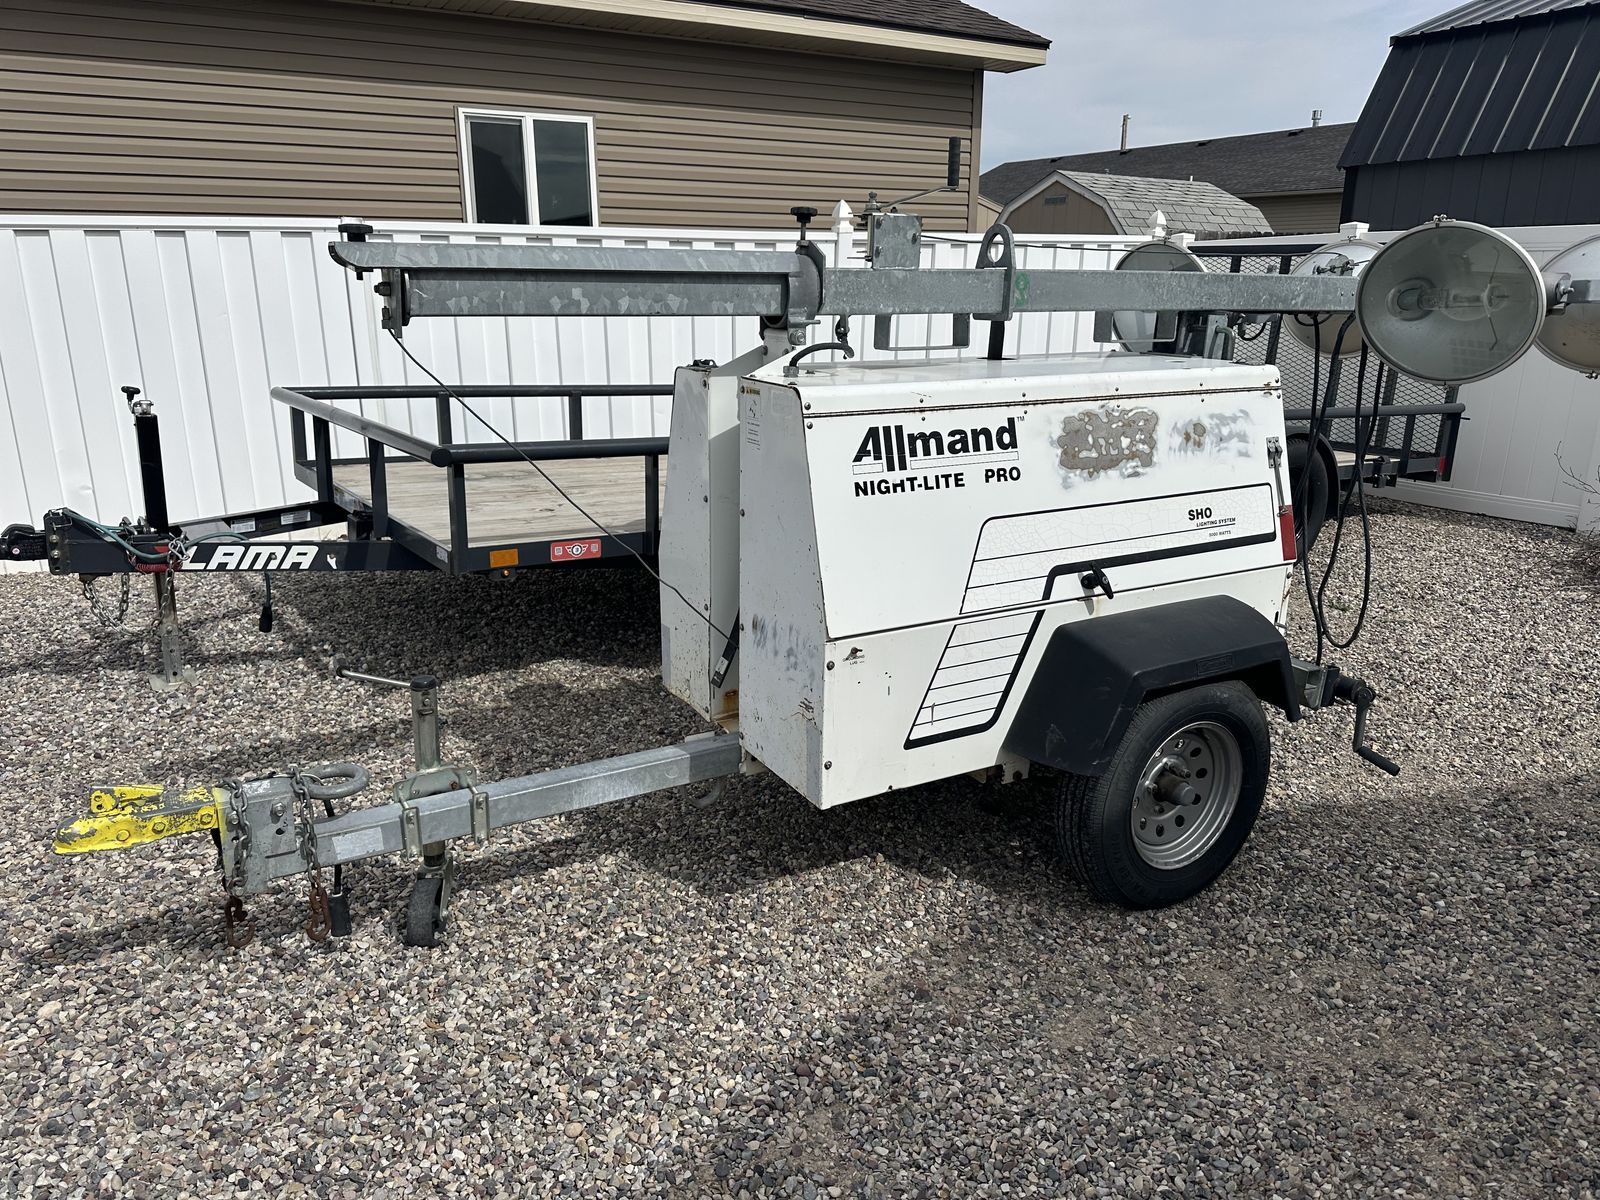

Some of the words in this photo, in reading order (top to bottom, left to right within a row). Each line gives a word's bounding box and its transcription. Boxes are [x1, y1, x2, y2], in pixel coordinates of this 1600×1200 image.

[852, 417, 1018, 472] Allmand
[854, 472, 966, 497] NIGHT-LITE
[984, 466, 1021, 483] PRO
[1188, 507, 1212, 521] SHO
[181, 545, 337, 570] LAMA
